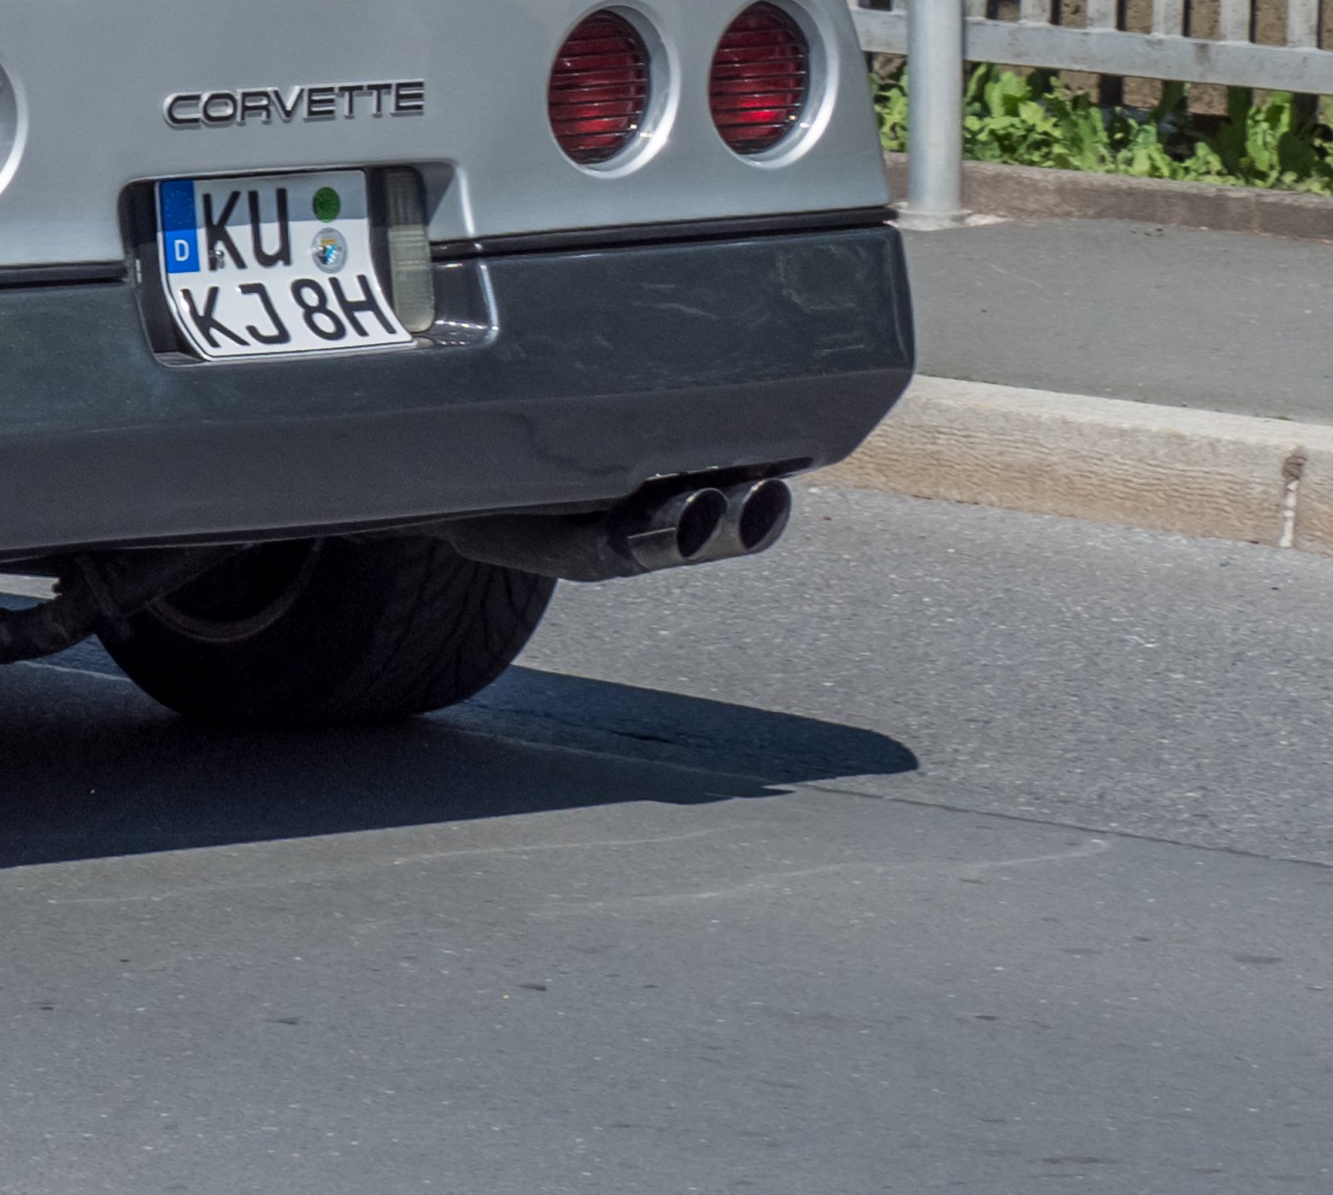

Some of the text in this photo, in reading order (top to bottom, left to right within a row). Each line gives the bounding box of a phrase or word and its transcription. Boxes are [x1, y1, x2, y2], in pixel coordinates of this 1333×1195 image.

[163, 79, 425, 129] CORVETTE
[173, 239, 190, 262] D
[202, 187, 292, 271] KU
